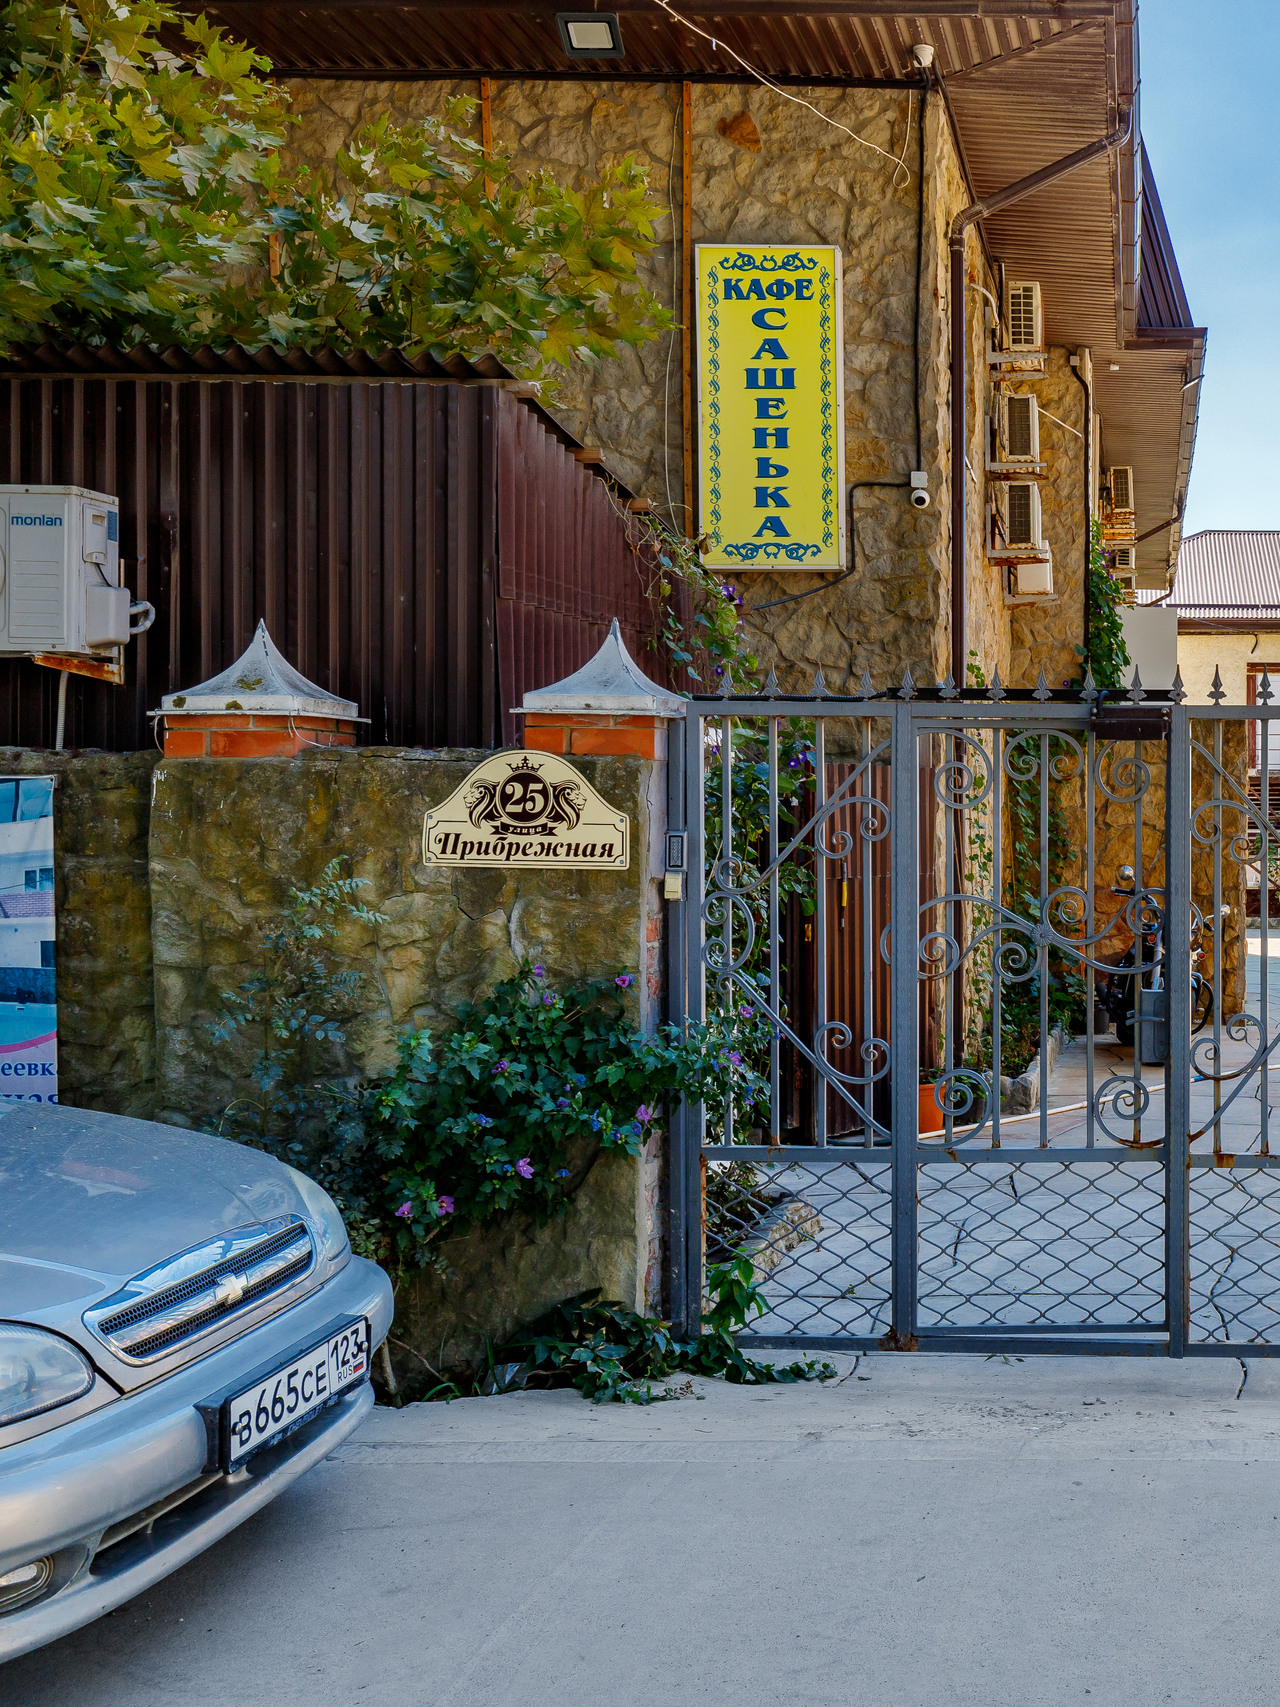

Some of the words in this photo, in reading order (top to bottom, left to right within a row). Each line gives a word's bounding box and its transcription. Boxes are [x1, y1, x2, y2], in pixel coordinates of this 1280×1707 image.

[722, 278, 815, 300] КАФЕ
[744, 307, 797, 537] САШЕНЬКА
[11, 514, 62, 526] monlan
[505, 782, 545, 814] 25
[508, 826, 542, 835] улица
[434, 832, 615, 861] Прибрежная
[1, 1062, 58, 1076] еевк
[331, 1327, 360, 1371] 123
[337, 1364, 353, 1383] RUS
